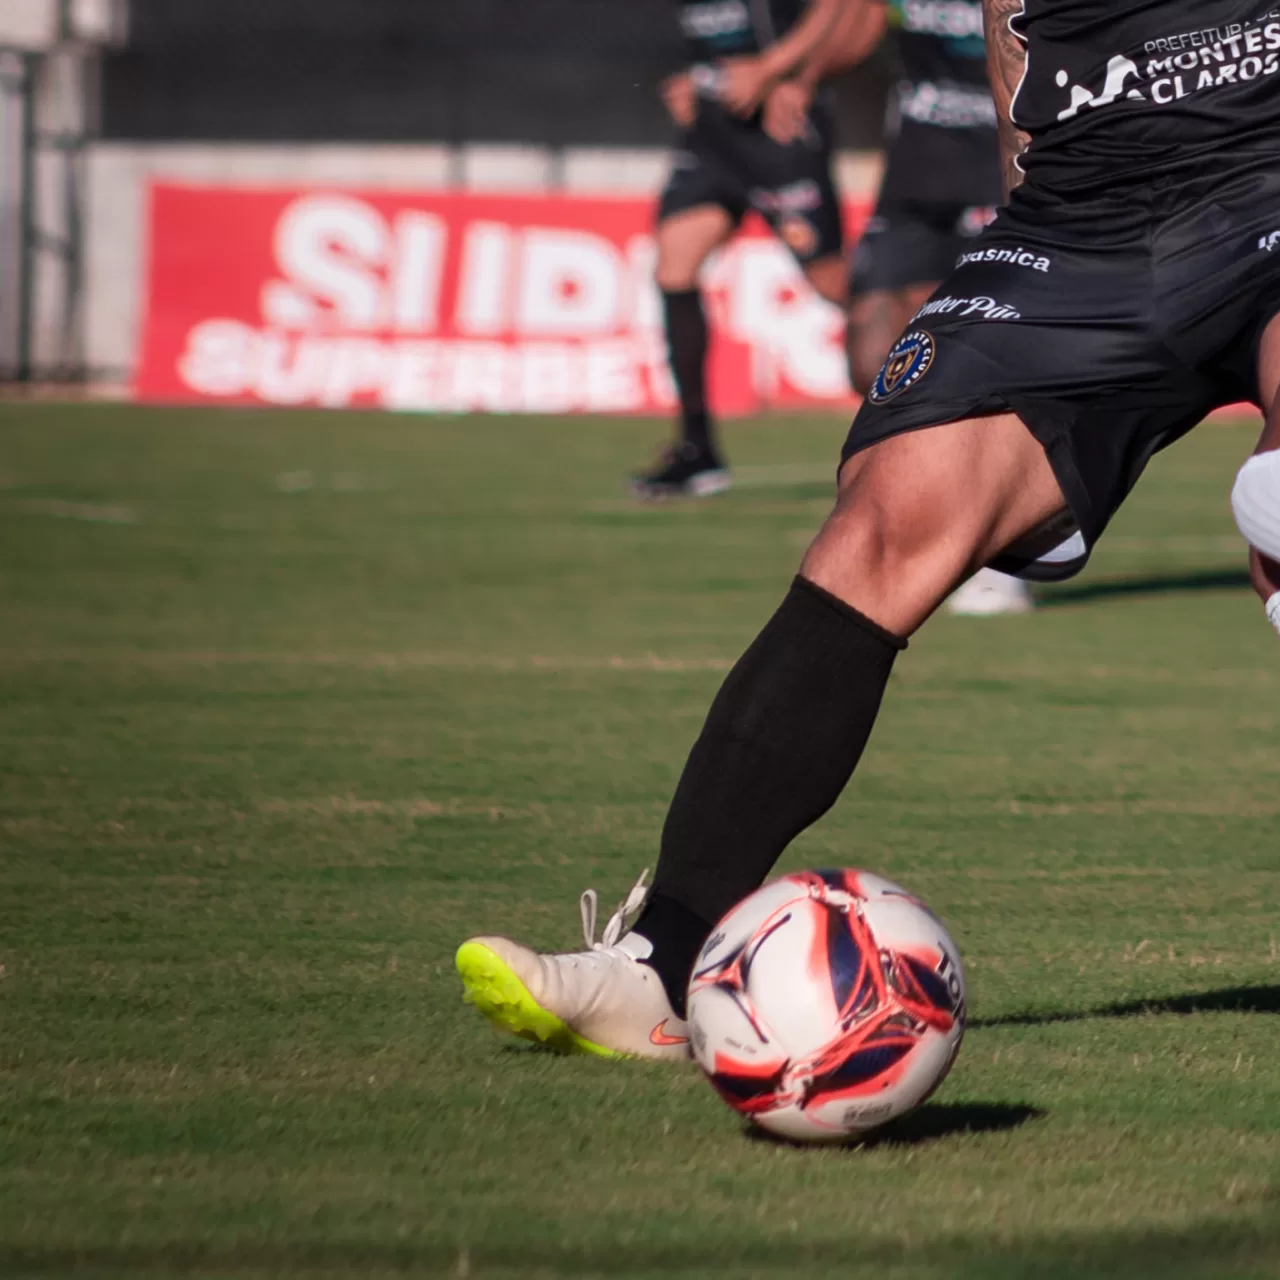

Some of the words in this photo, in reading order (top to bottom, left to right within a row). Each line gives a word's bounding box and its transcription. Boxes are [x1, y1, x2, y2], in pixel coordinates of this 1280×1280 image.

[1144, 21, 1250, 53] PREFEITUR
[1151, 53, 1279, 104] CLAROS
[180, 320, 690, 410] SUPERBE
